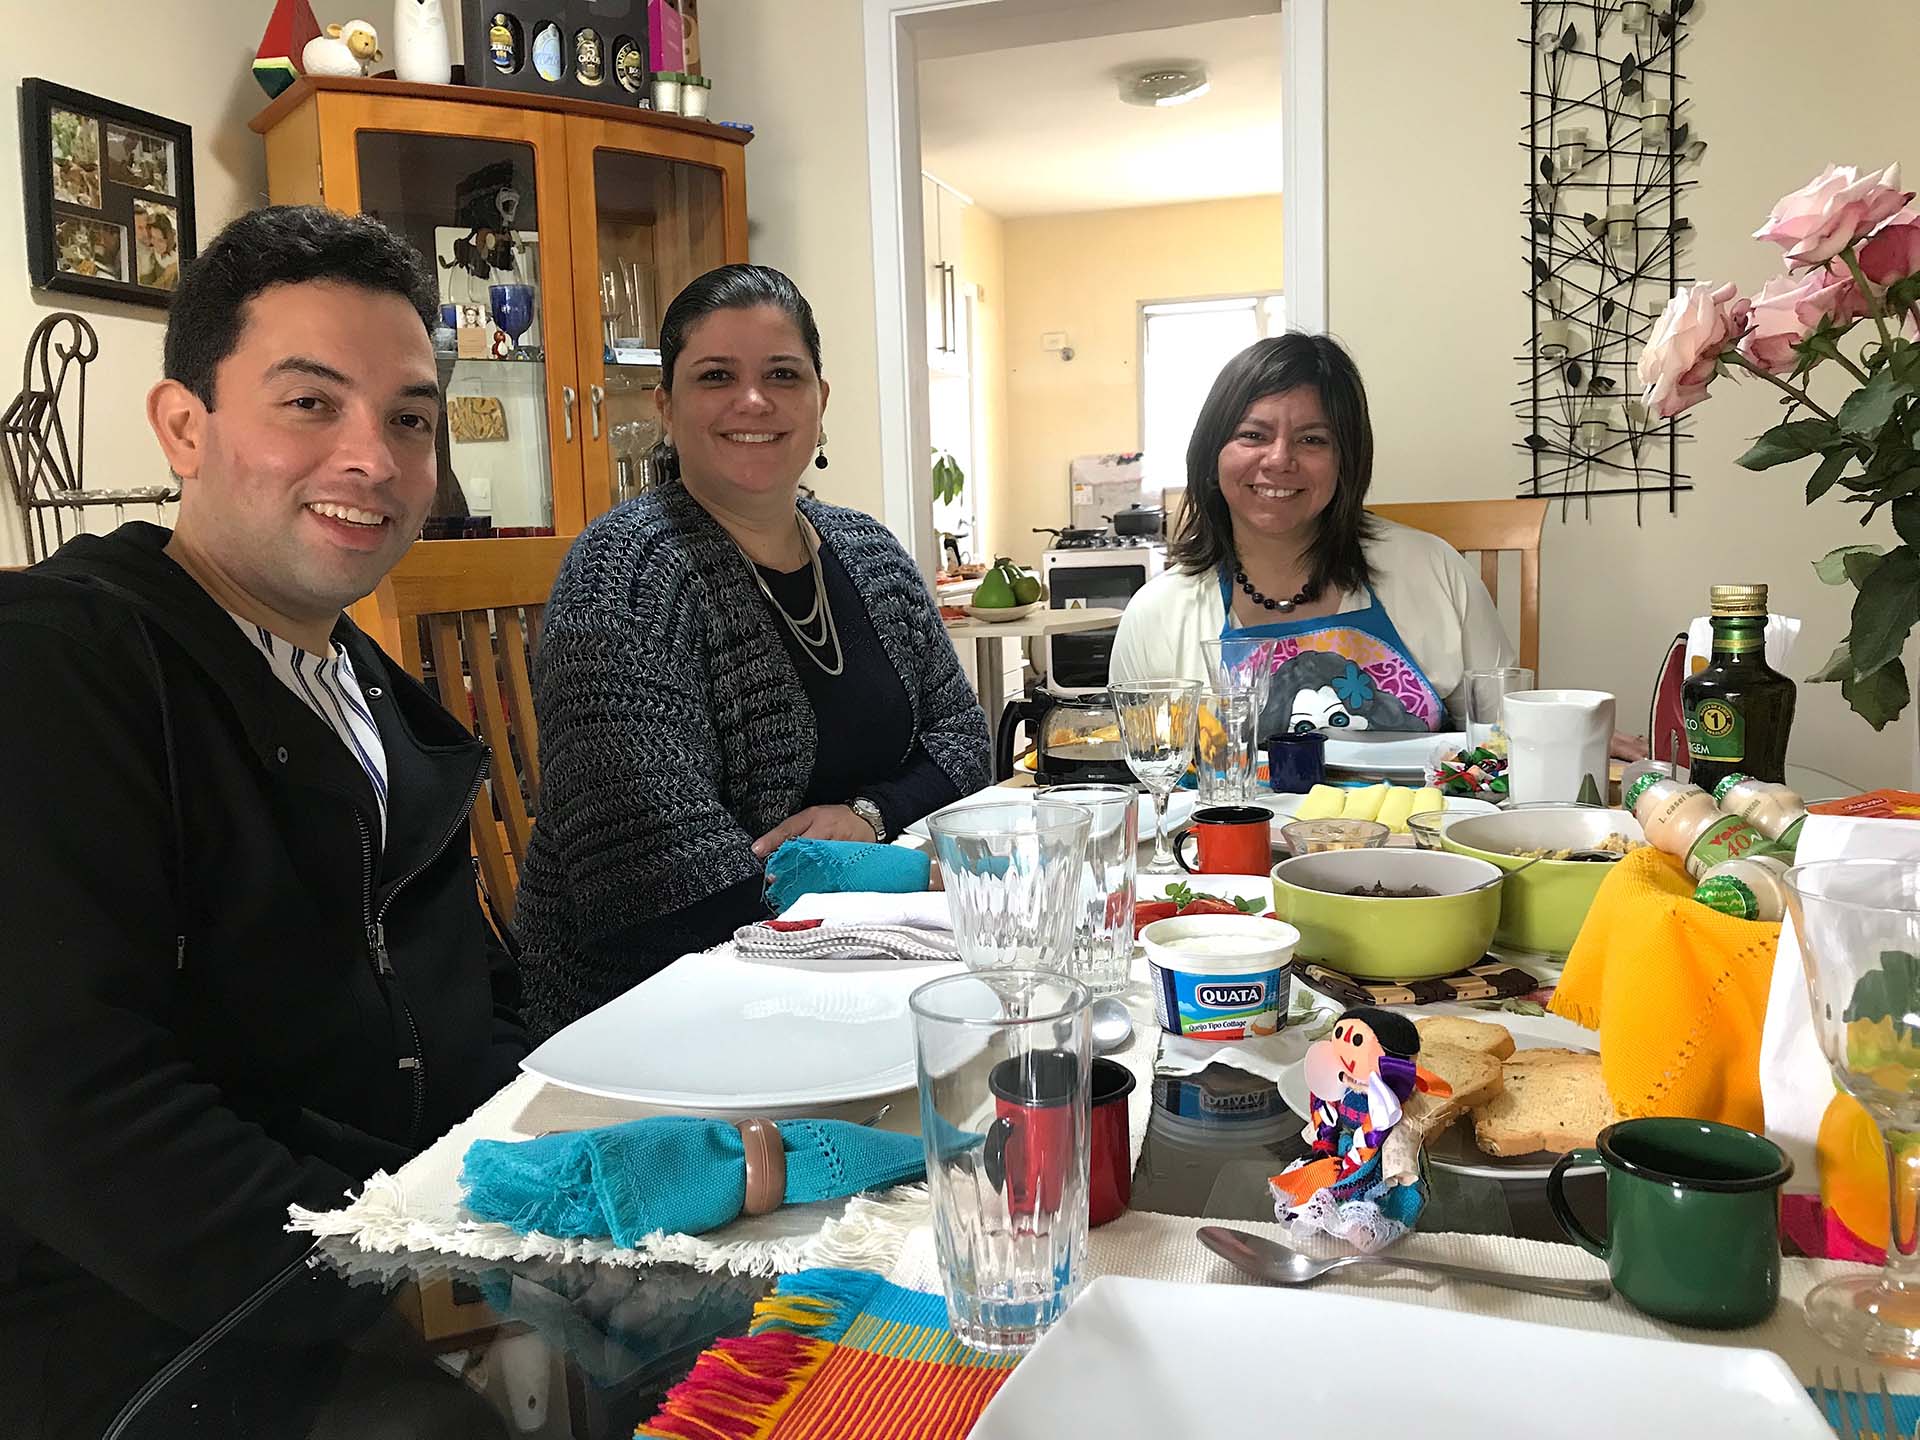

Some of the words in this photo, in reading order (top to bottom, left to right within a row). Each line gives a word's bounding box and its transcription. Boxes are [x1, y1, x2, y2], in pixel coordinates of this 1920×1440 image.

[1666, 796, 1686, 815] casei
[1727, 834, 1751, 858] 40
[1189, 1023, 1208, 1033] Queijo
[1208, 1022, 1222, 1031] Tipo
[1223, 1020, 1247, 1030] Cottage
